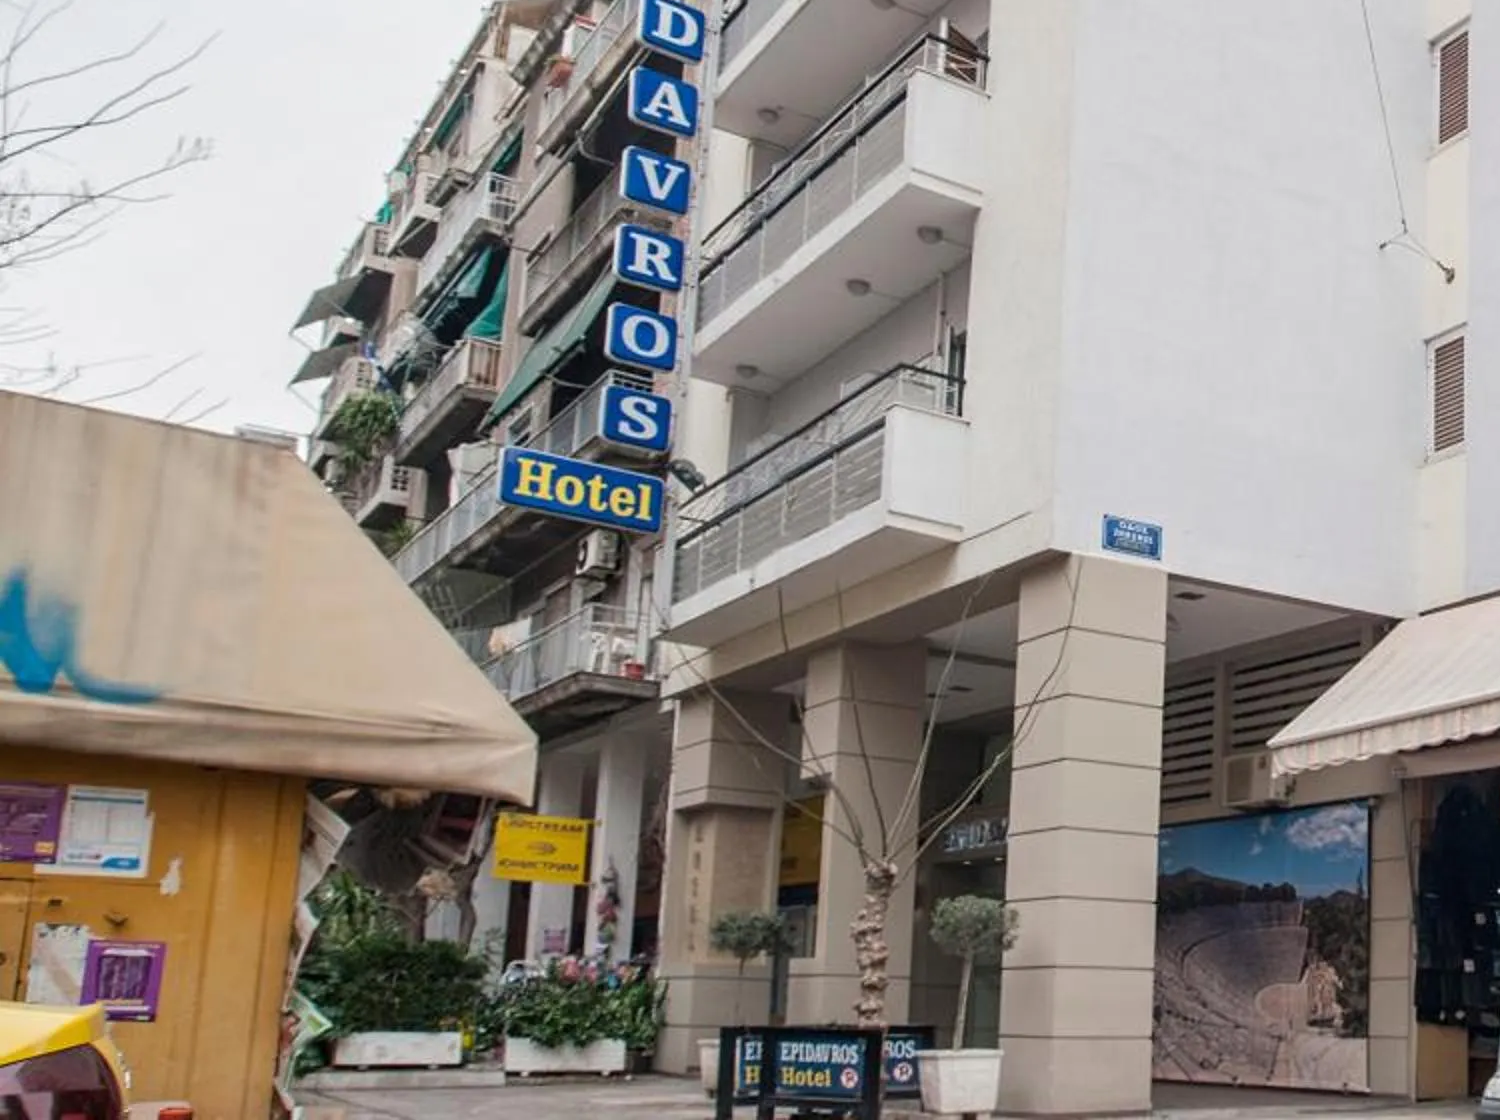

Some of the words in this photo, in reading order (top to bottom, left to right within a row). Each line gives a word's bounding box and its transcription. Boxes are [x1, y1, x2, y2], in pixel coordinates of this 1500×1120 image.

[513, 457, 652, 521] Hotel
[780, 1041, 859, 1066] EPIDAVROS
[781, 1066, 832, 1088] Hotel
